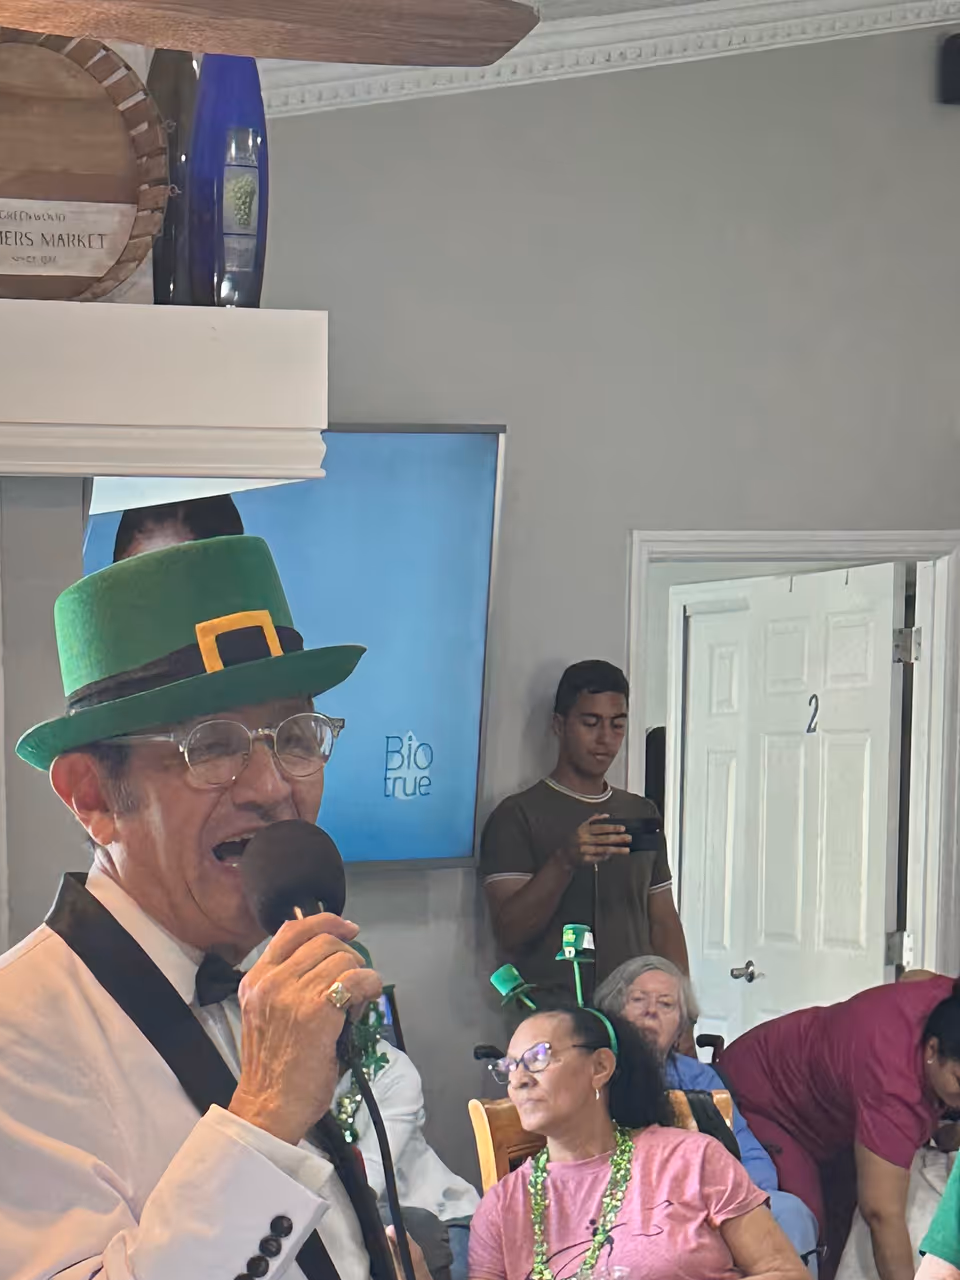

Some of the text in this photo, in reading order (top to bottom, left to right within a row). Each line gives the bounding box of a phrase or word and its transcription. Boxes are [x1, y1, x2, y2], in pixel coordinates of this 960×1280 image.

[40, 232, 107, 250] MARKET
[806, 693, 819, 734] 2
[384, 734, 434, 770] Bio
[384, 775, 432, 798] true
